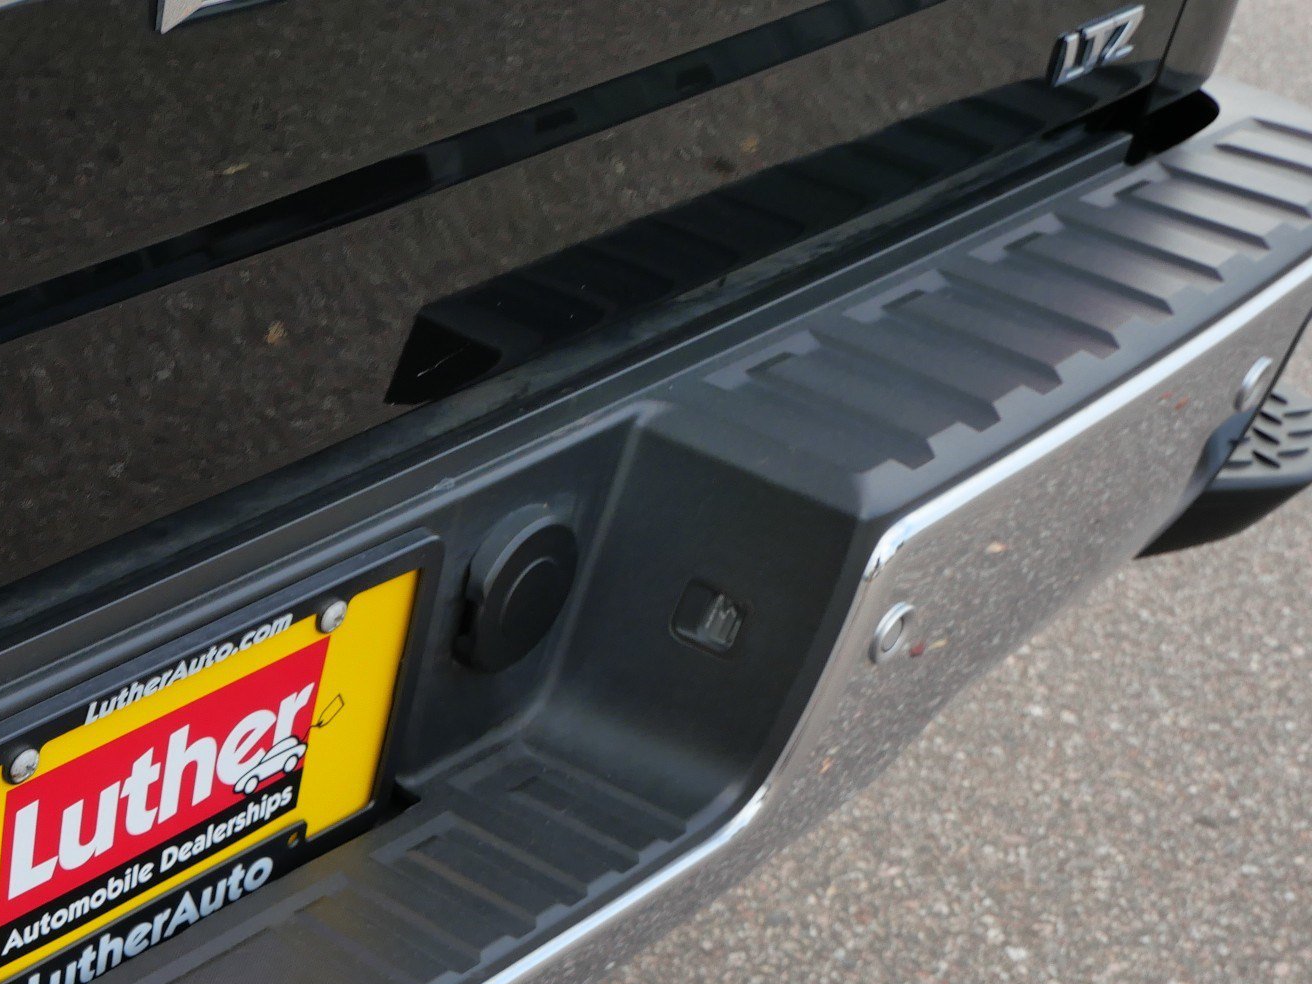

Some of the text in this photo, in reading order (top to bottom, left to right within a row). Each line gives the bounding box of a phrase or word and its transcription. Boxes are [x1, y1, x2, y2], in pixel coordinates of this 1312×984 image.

[1045, 3, 1145, 87] LTZ
[84, 612, 294, 726] LutherAuto.com
[8, 682, 315, 900] Luther
[1, 786, 294, 956] Automobile Dealerships
